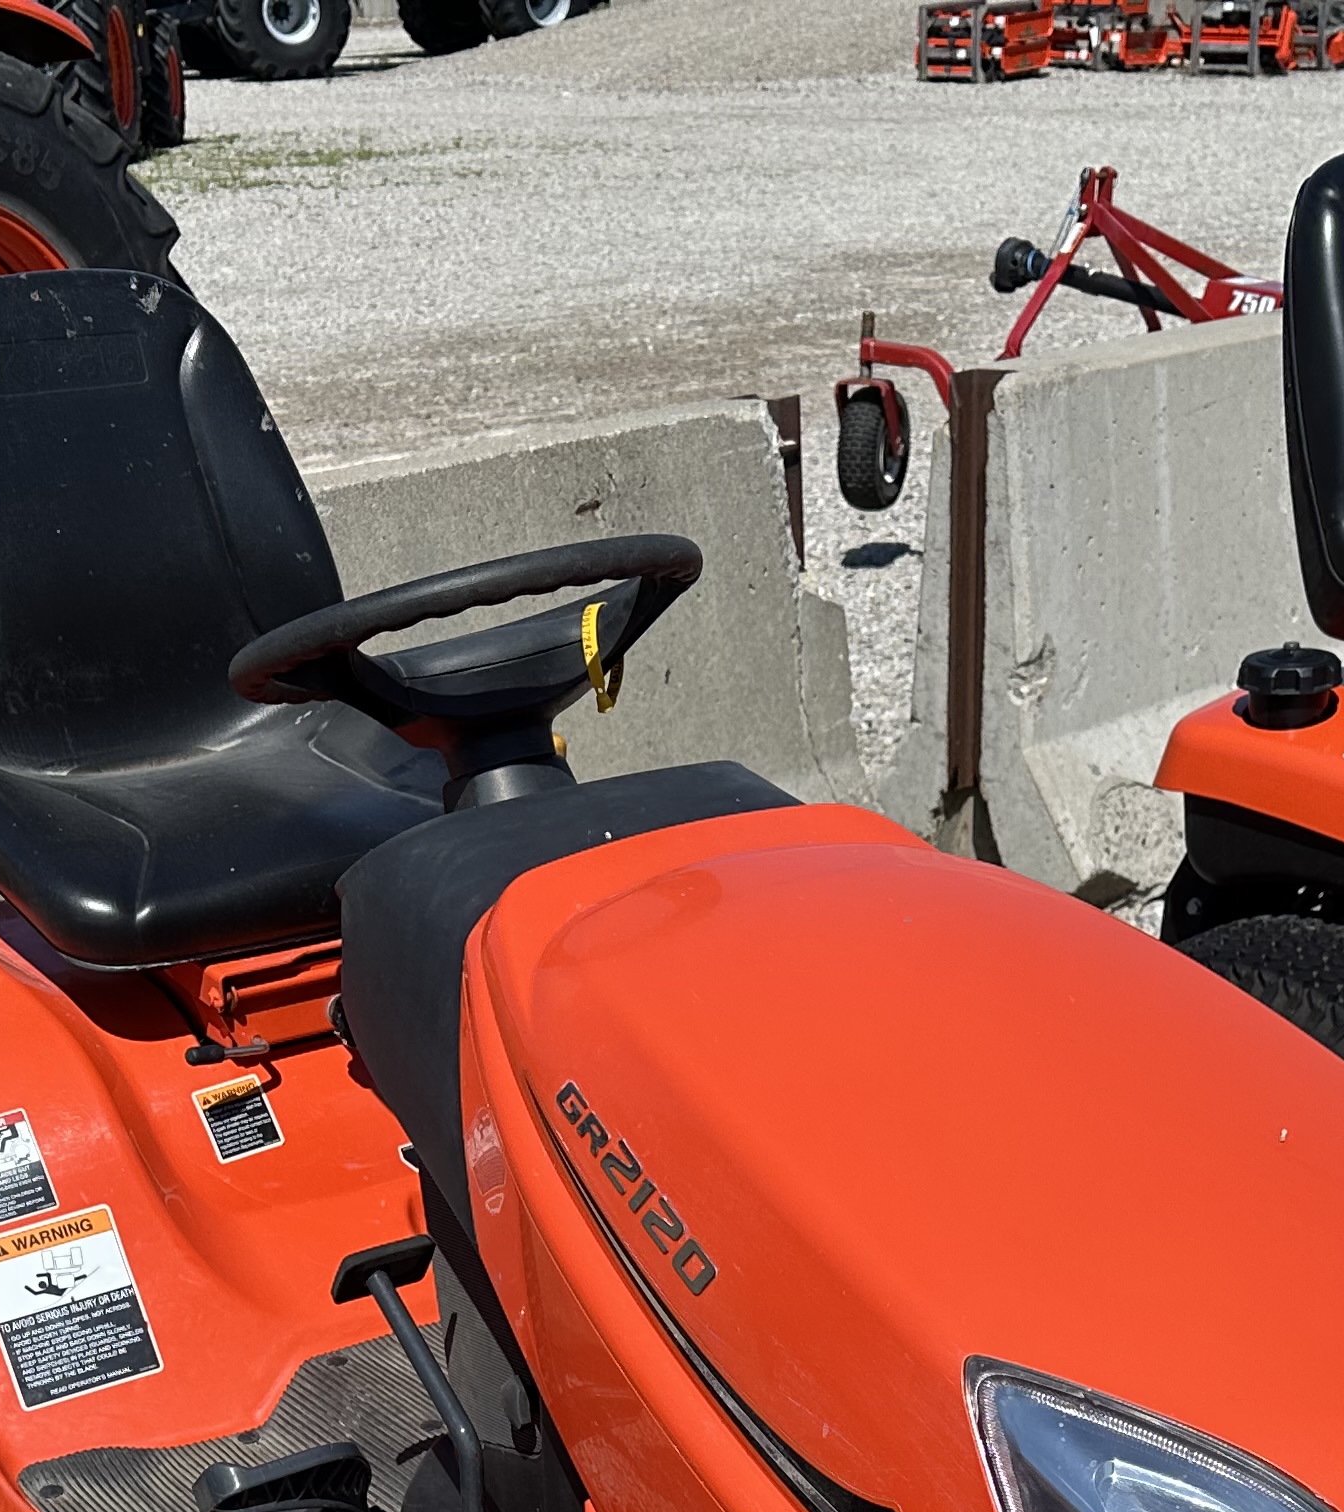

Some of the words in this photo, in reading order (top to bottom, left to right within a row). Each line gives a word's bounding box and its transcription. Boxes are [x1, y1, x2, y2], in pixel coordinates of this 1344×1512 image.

[1227, 289, 1276, 313] 750
[211, 1082, 256, 1102] WARNING
[555, 1080, 719, 1296] GR2120
[11, 1218, 94, 1252] WARNING
[0, 1322, 12, 1333] TO
[10, 1315, 36, 1330] AVOID
[34, 1305, 70, 1323] SERIOUS
[69, 1297, 98, 1313] INJURY
[97, 1293, 111, 1305] OR
[109, 1287, 135, 1302] DEATH
